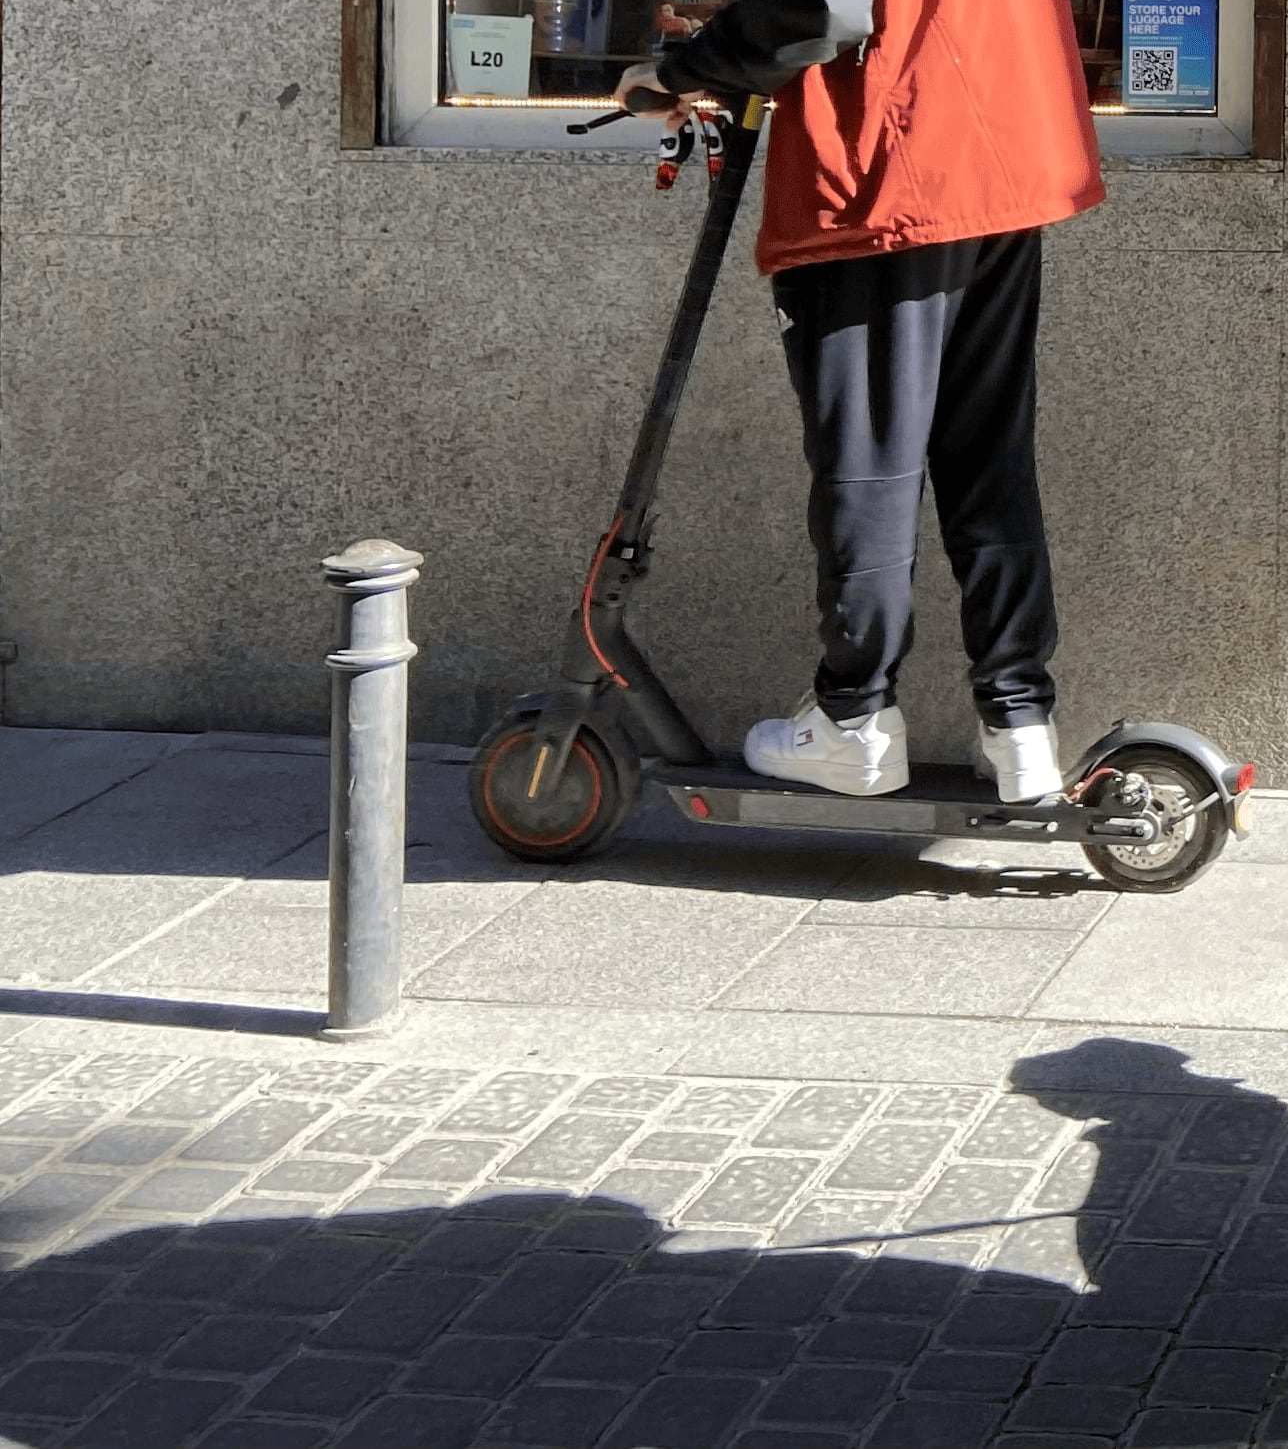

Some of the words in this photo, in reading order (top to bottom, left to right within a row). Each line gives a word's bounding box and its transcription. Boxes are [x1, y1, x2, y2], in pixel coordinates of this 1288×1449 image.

[1129, 5, 1167, 15] STORE
[1169, 5, 1201, 16] YOUR
[1129, 15, 1185, 25] LUGGAGE
[1129, 25, 1160, 35] HERE
[470, 50, 504, 68] L20
